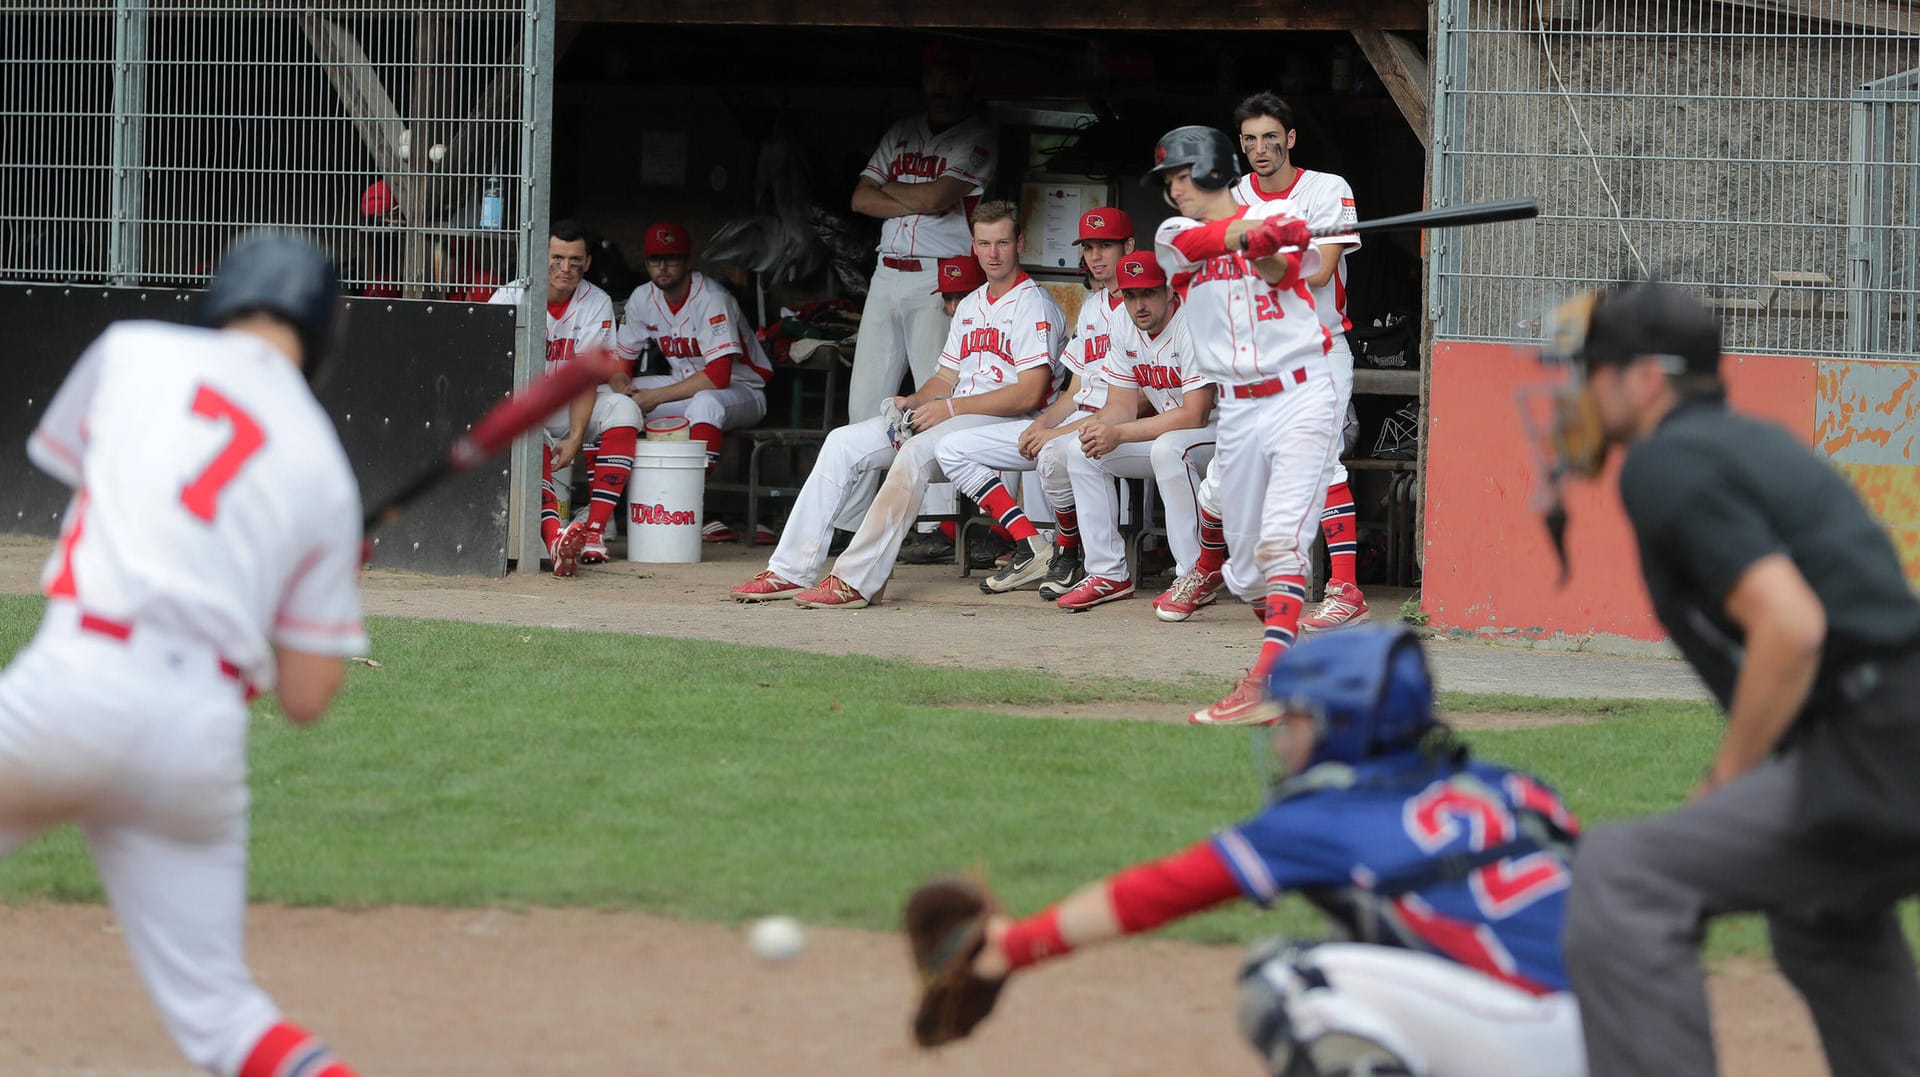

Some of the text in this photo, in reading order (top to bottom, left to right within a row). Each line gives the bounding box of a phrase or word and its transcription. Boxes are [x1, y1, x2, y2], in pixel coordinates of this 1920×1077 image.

[990, 365, 1004, 384] 3
[179, 384, 266, 524] 7
[630, 502, 696, 525] Wilson
